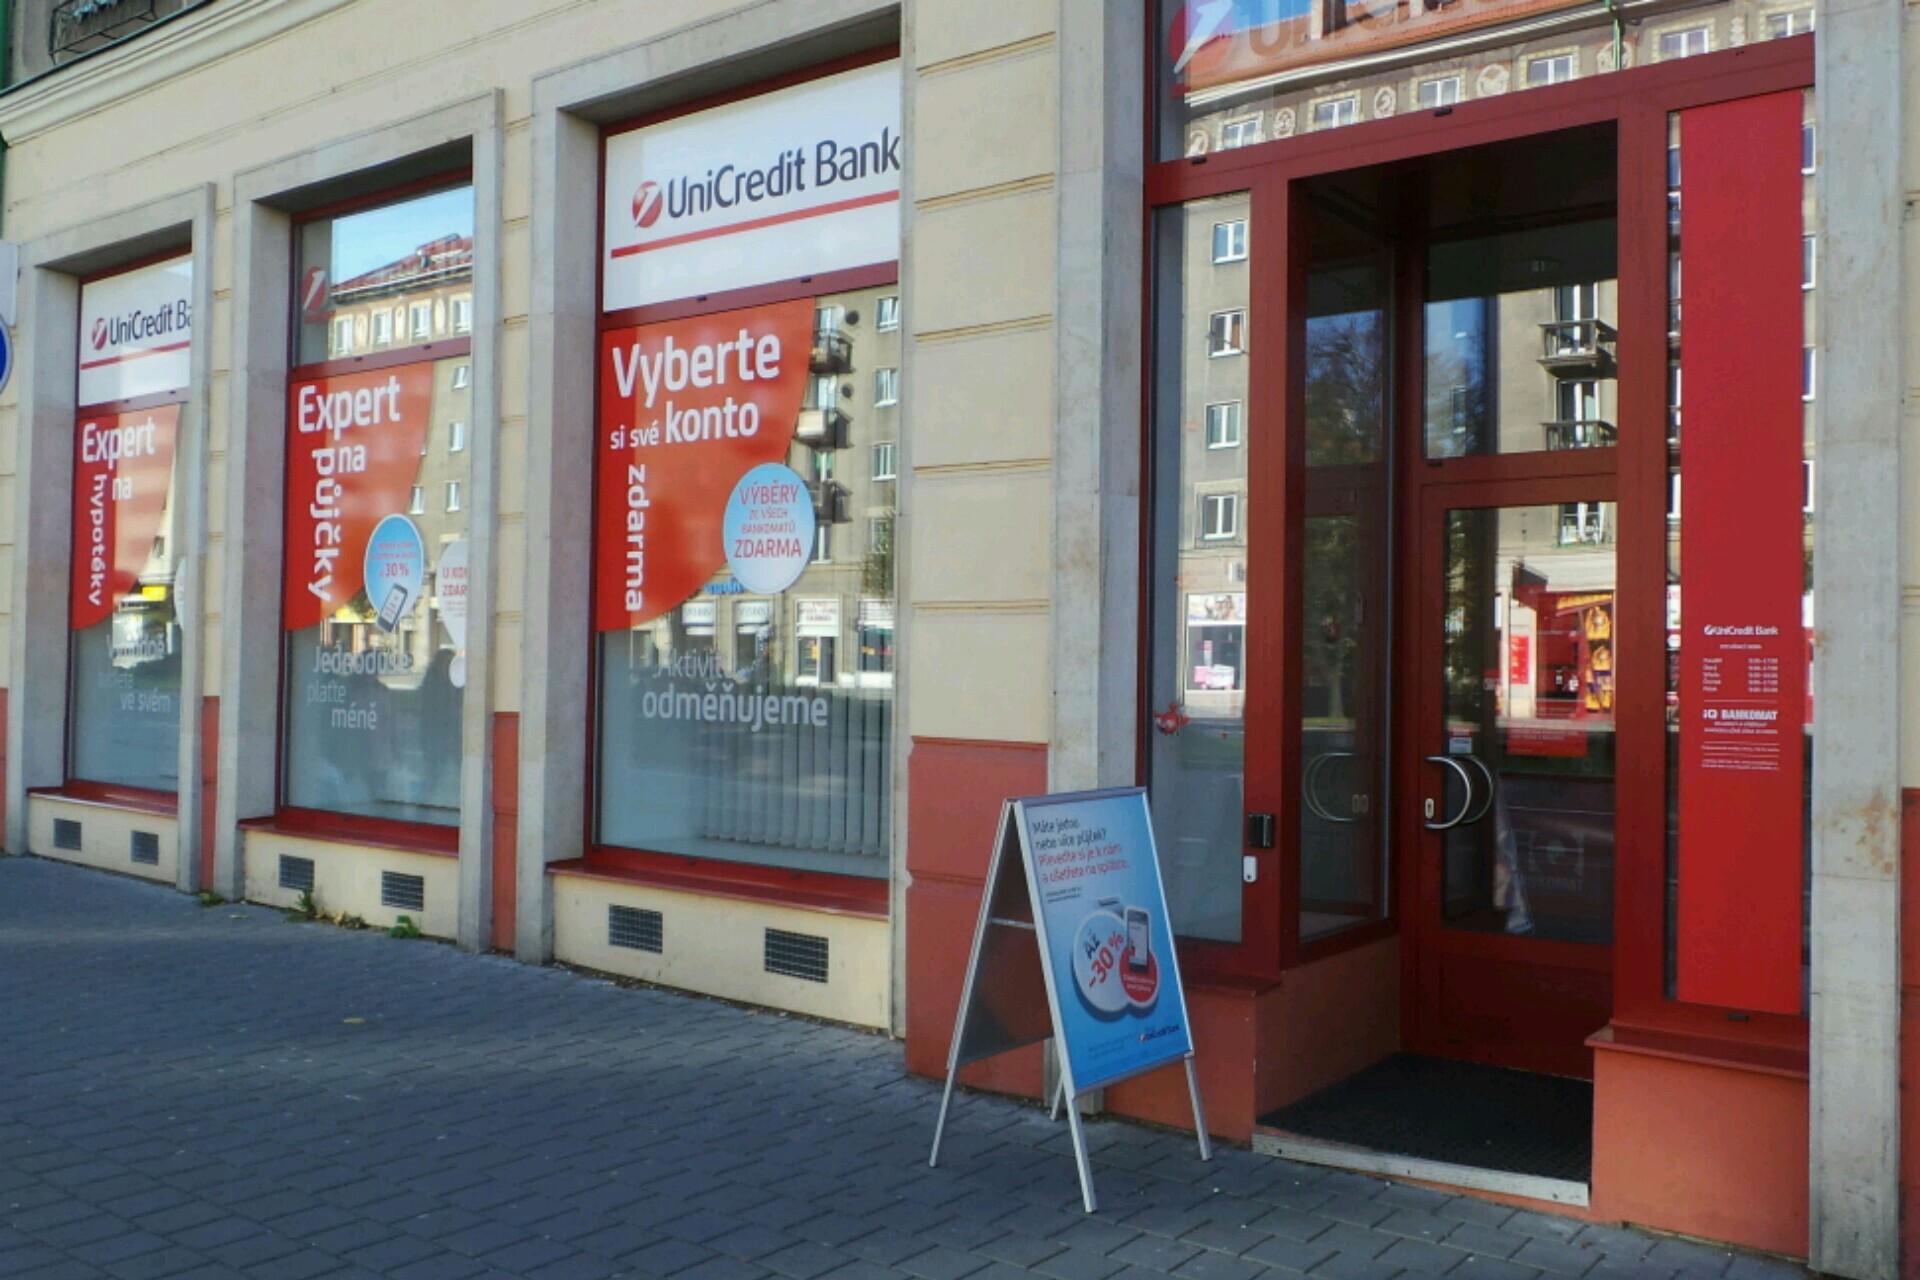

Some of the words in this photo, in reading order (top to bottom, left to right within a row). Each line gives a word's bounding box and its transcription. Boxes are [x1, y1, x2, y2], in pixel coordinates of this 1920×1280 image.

[667, 147, 806, 219] UniCredit
[109, 303, 173, 346] UniCredit
[612, 328, 782, 409] Vyberte
[298, 374, 401, 441] Expert
[610, 424, 625, 450] si
[629, 419, 659, 448] své
[665, 396, 760, 444] konto
[82, 416, 156, 470] Expert
[337, 443, 367, 474] na
[111, 476, 133, 501] na
[739, 479, 800, 505] VÝBĚRY
[88, 473, 108, 607] hypotéky
[307, 447, 343, 603] půjčky
[625, 463, 650, 612] zdarma
[734, 538, 802, 559] ZDARMA
[641, 681, 829, 733] odměňujeme
